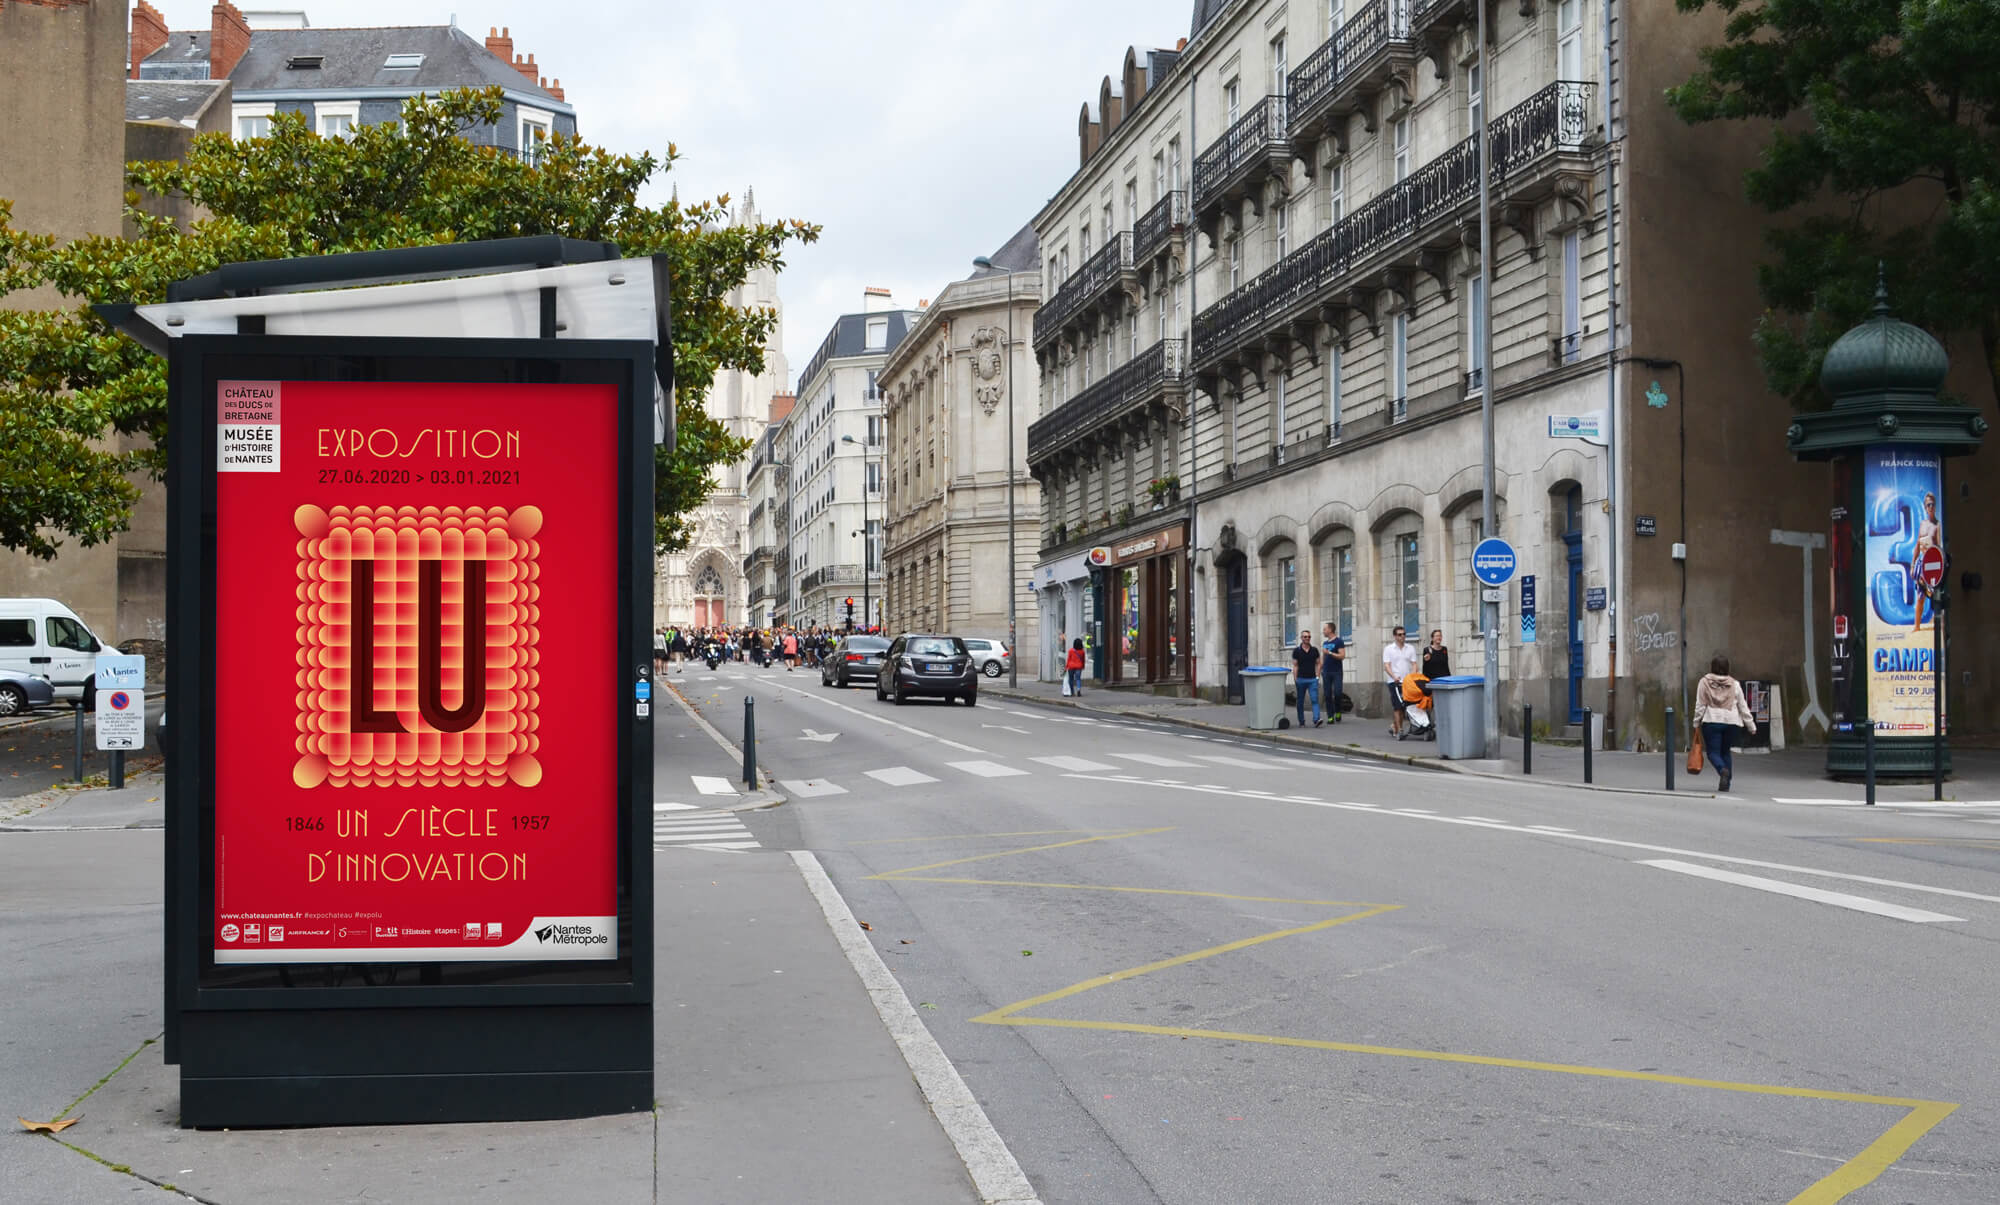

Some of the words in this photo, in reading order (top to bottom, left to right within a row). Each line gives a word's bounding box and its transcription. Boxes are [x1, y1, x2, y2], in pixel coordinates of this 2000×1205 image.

[225, 387, 273, 398] CHÂTEAU
[238, 401, 263, 409] DUCS
[225, 412, 273, 420] BRETAGNE
[225, 426, 273, 441] MUSÉE
[225, 444, 273, 452] D'HISTOIRE
[318, 428, 520, 459] EXPOSITION
[235, 455, 273, 464] NANTES
[1881, 459, 1914, 468] FRANCK
[318, 469, 410, 484] 27.06.2020
[430, 470, 520, 485] 03.01.2021
[351, 559, 487, 733] LU
[1895, 687, 1905, 695] LE
[1908, 687, 1919, 695] 29
[285, 816, 325, 832] 1846
[337, 808, 368, 838] UN
[384, 804, 498, 838] SIÈCLE
[511, 815, 550, 831] 1957
[308, 850, 526, 883] D'INNOVATION
[304, 911, 353, 919] #expochateau
[553, 924, 592, 935] Nantes
[553, 933, 608, 946] Métropole
